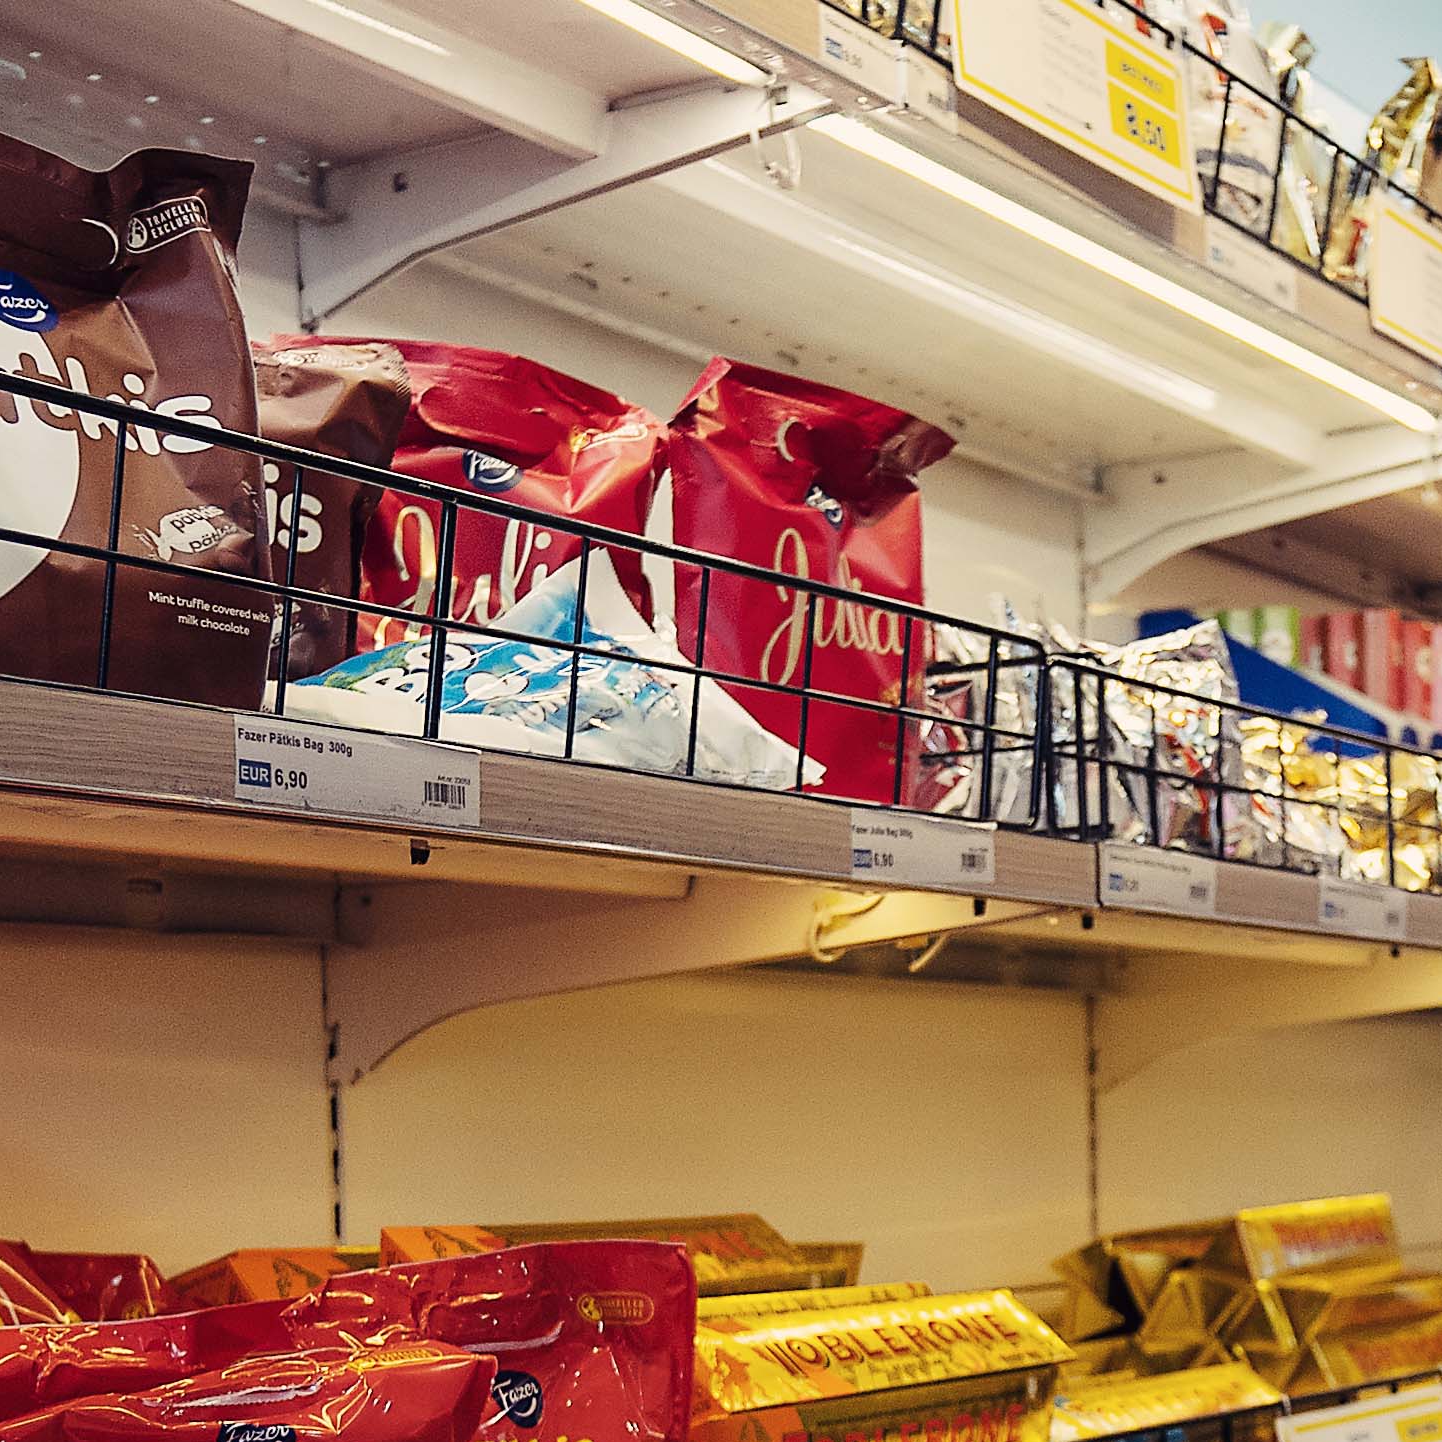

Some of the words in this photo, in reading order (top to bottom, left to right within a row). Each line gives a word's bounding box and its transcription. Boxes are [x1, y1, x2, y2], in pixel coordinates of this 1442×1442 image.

[361, 504, 554, 652] Juli
[149, 592, 175, 607] Mint
[176, 595, 211, 612] truffle
[211, 600, 252, 620] covered
[252, 610, 272, 624] with
[177, 614, 199, 627] milk
[200, 615, 251, 637] chocolate
[237, 727, 268, 744] Fazer
[269, 732, 302, 749] Pätkis
[303, 737, 324, 754] Bag
[329, 741, 353, 758] 300g
[239, 765, 270, 785] EUR
[274, 770, 308, 791] 6,90
[493, 1377, 541, 1410] Fazer
